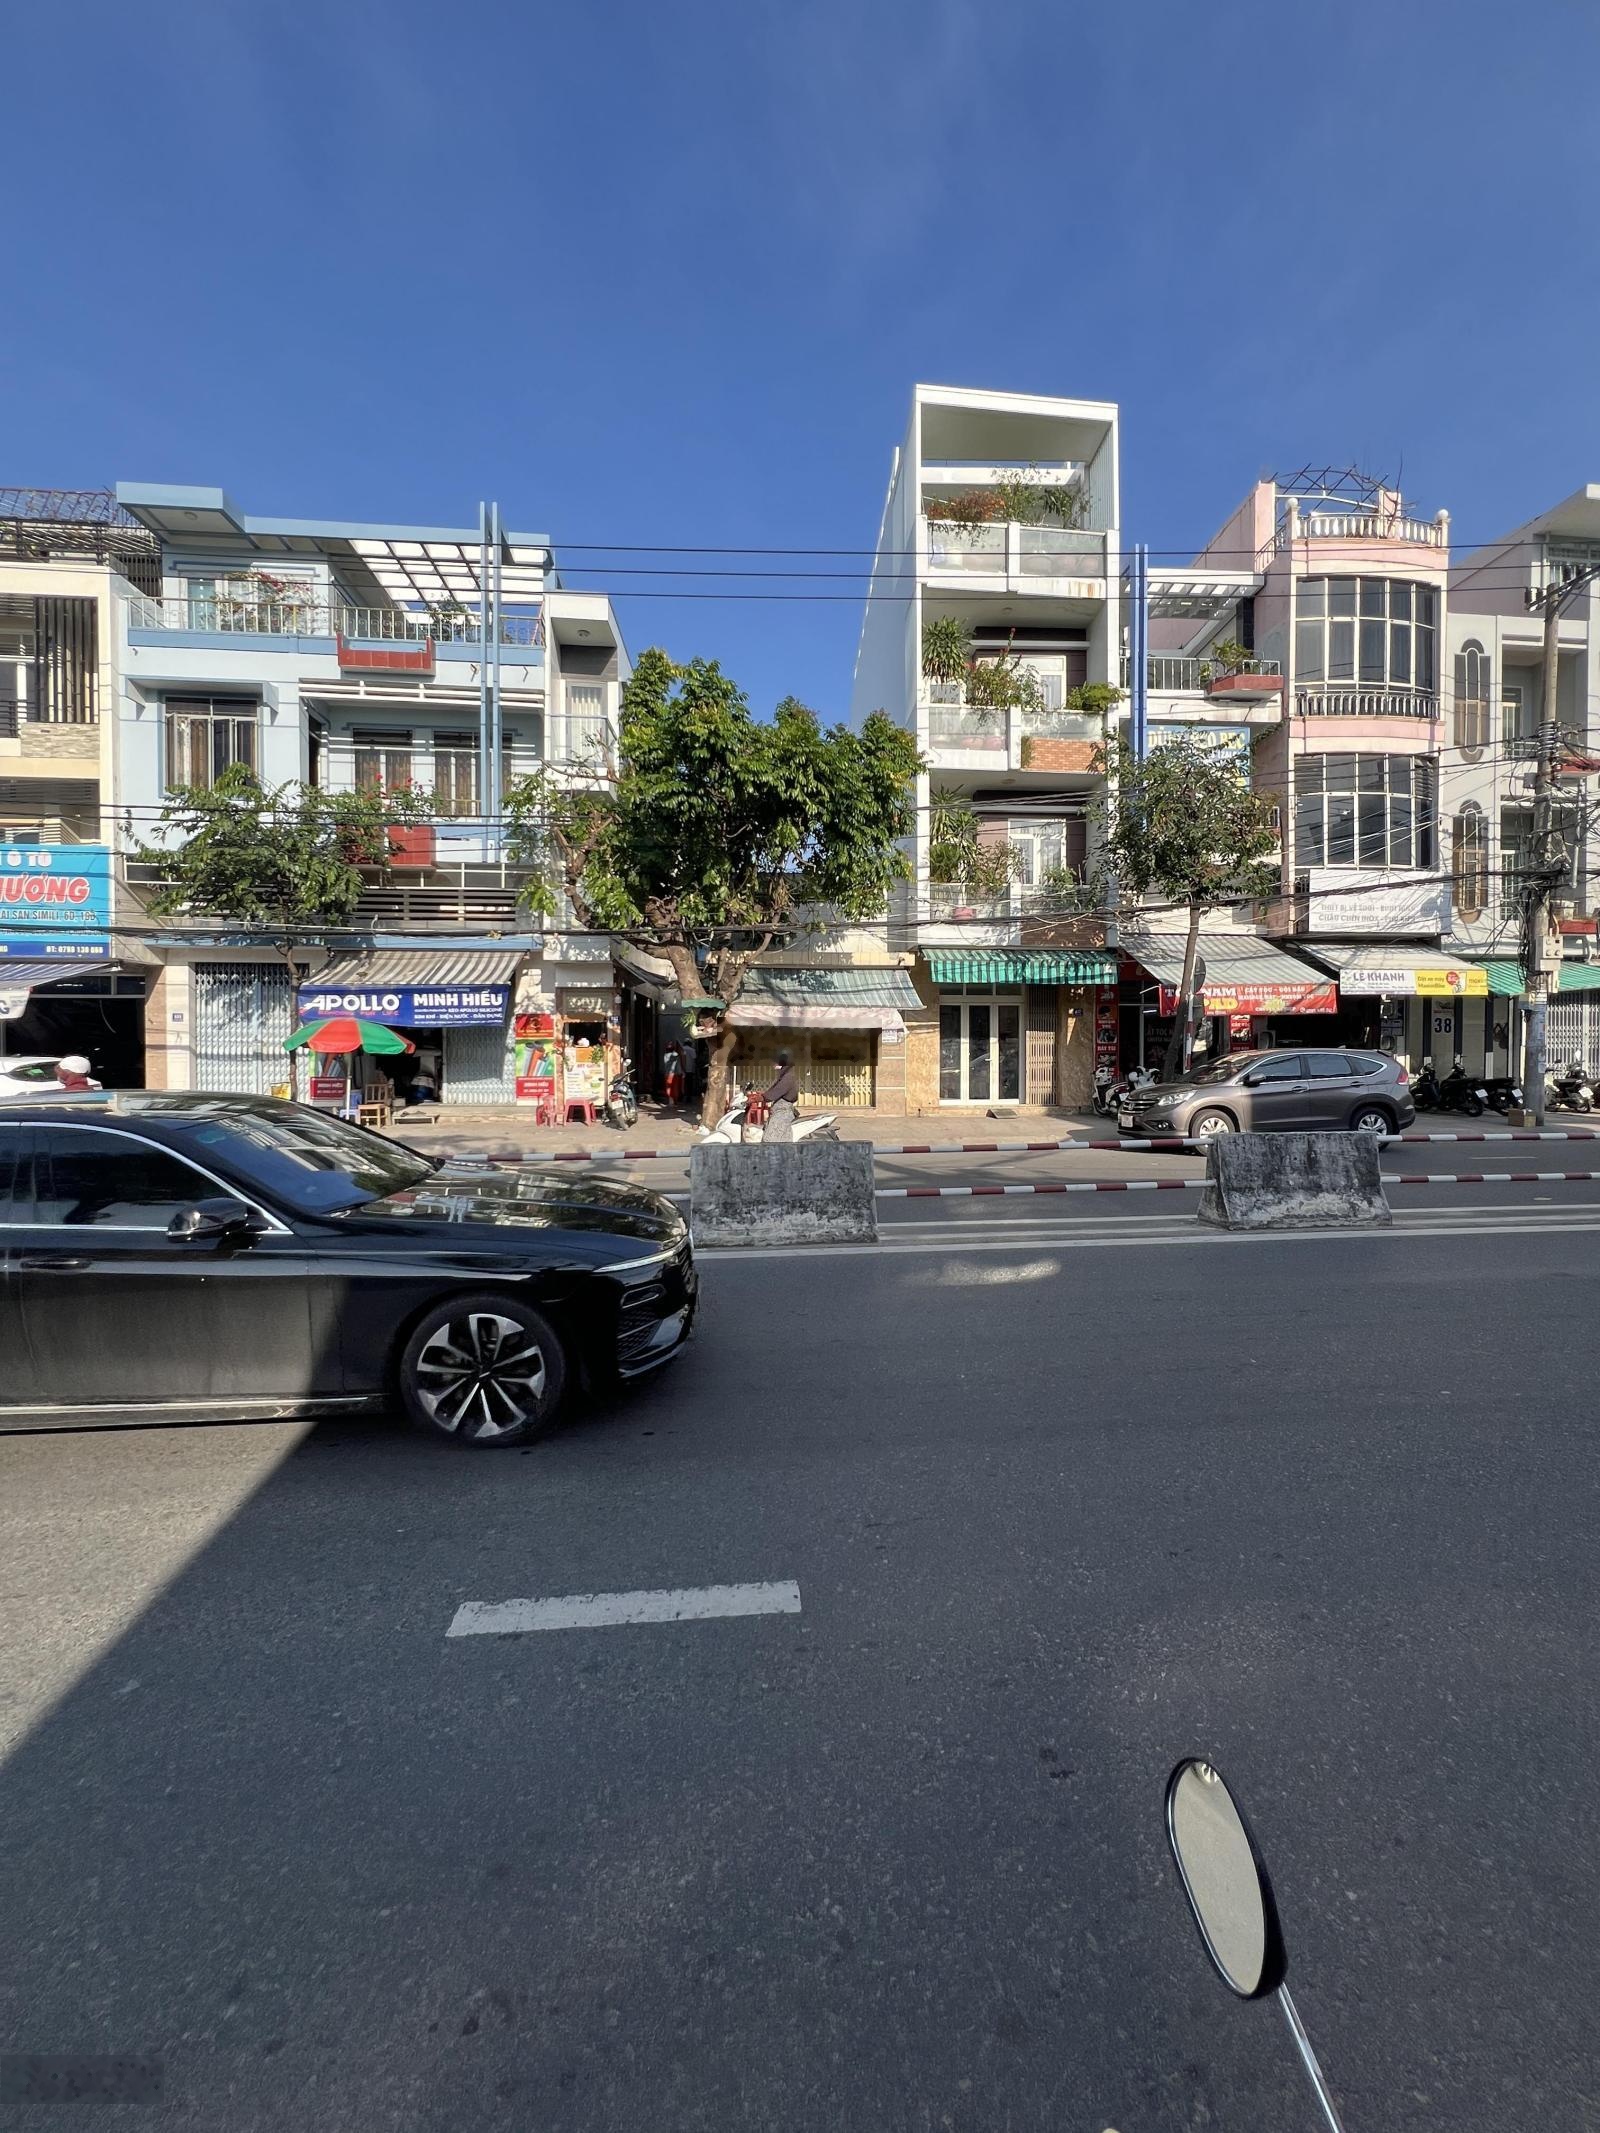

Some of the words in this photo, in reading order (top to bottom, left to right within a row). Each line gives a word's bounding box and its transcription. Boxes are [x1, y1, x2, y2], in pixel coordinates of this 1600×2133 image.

[1367, 972, 1405, 982] KHANH
[304, 994, 400, 1012] APOLLO
[413, 993, 458, 1007] MINH
[462, 989, 503, 1006] HIẾU
[1434, 1017, 1452, 1034] 38
